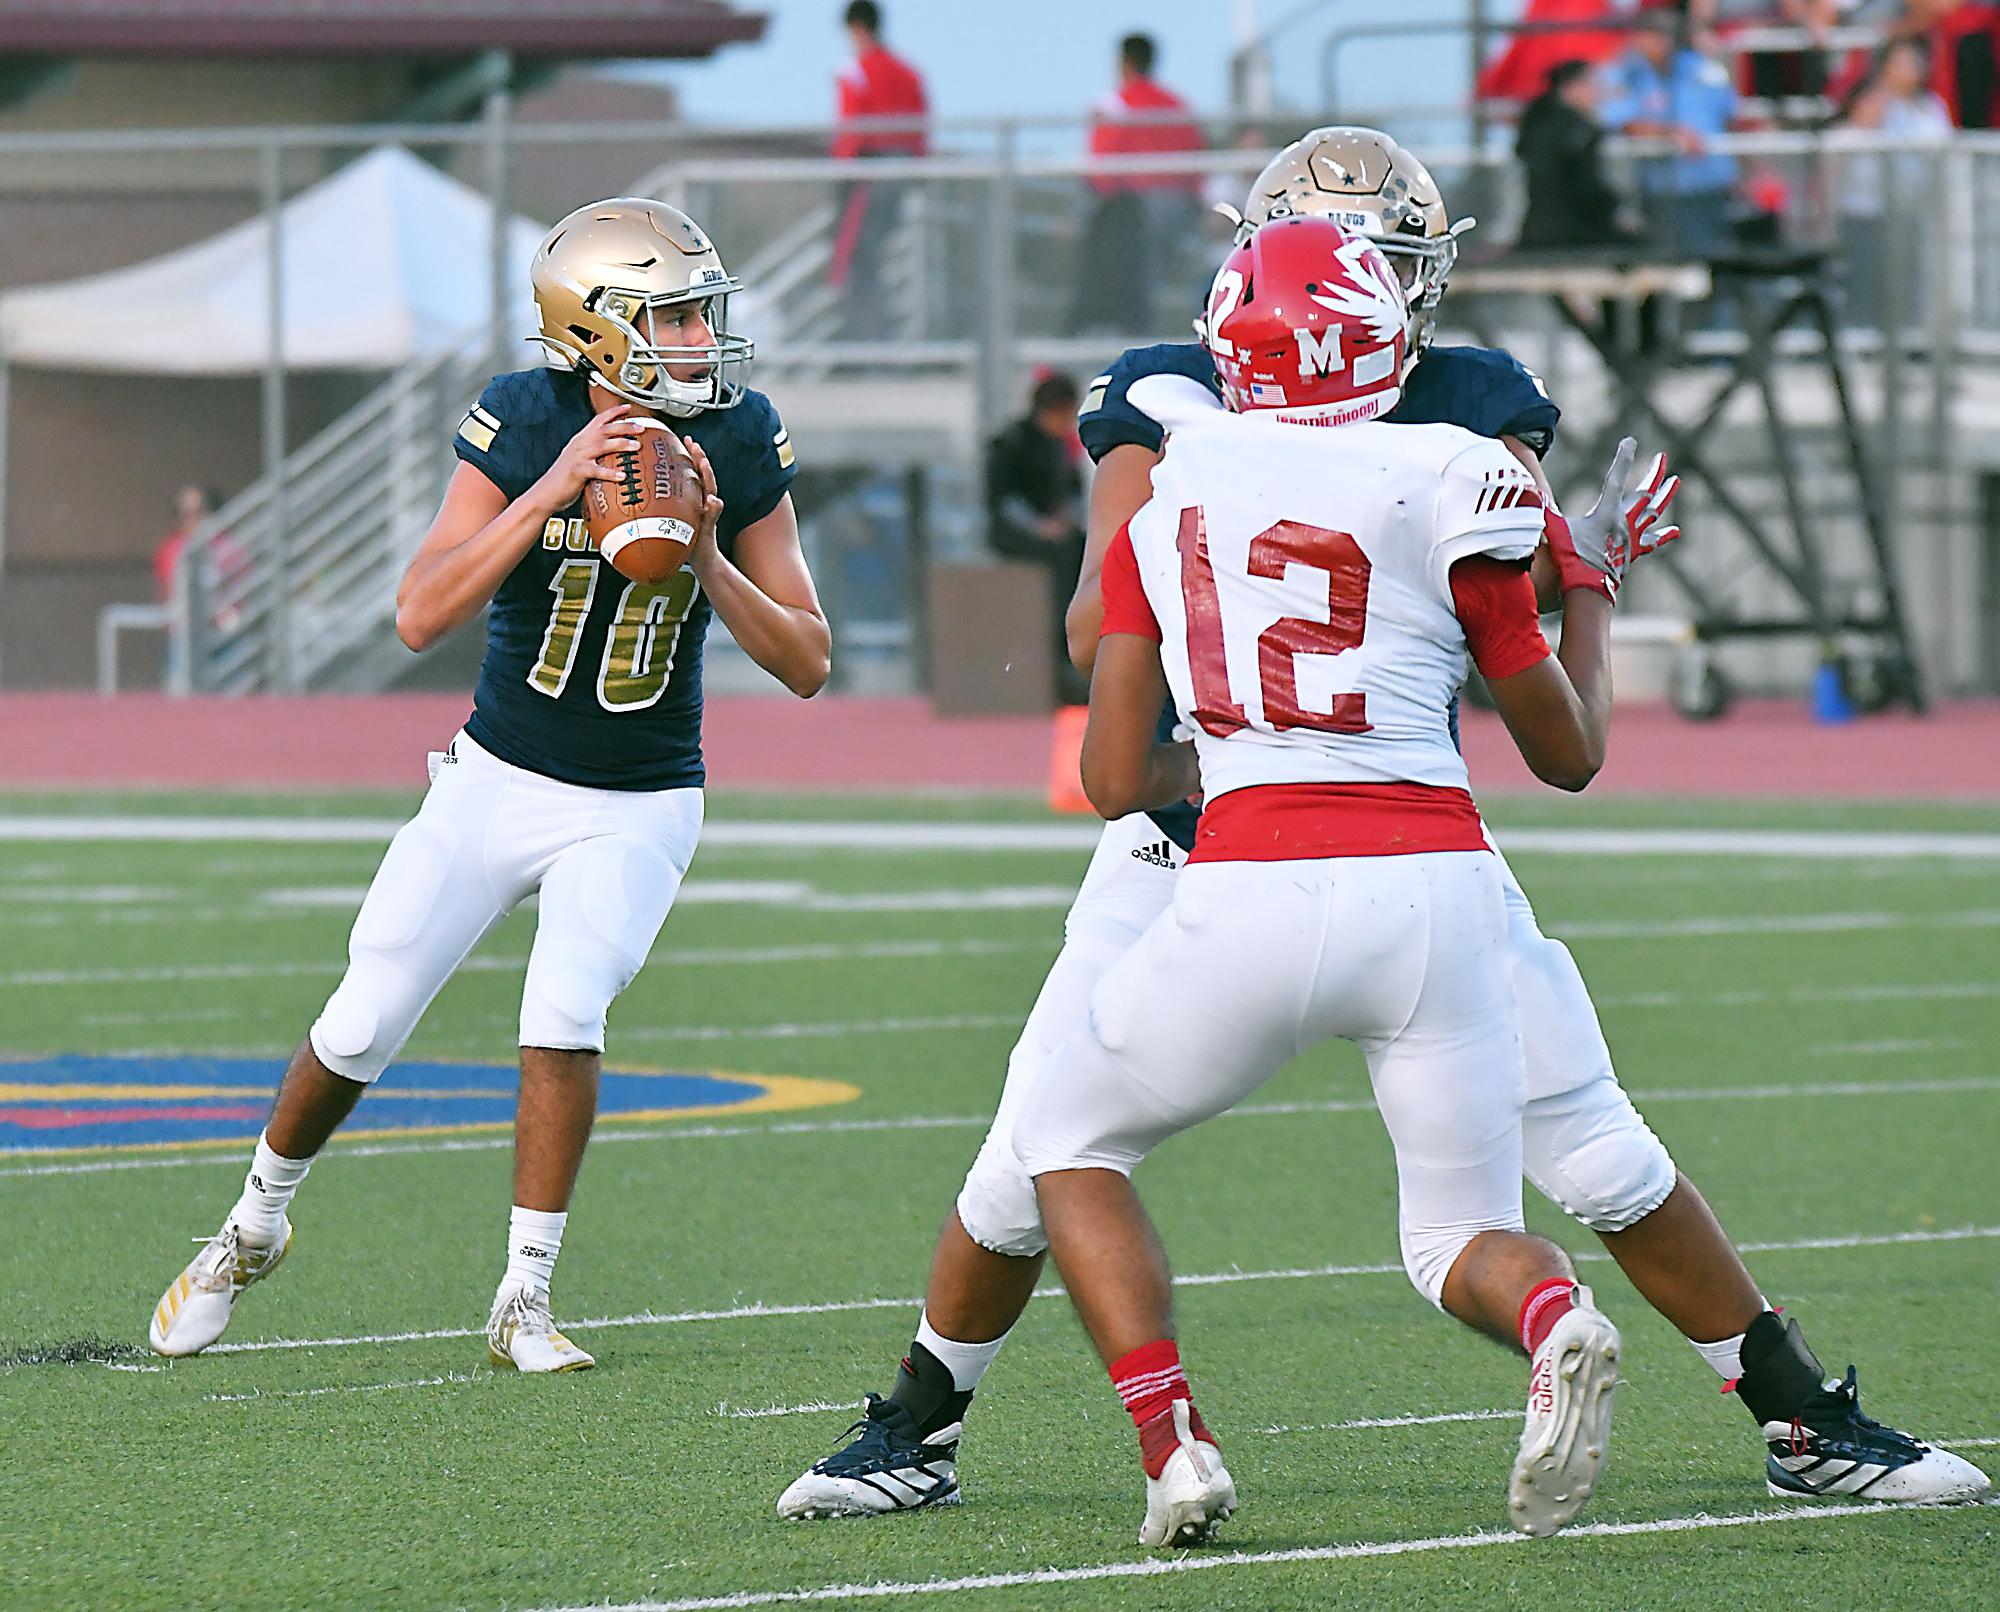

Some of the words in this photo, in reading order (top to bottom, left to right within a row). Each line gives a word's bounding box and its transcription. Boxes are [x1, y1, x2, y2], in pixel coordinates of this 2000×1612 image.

[1294, 322, 1346, 377] M
[652, 438, 672, 499] Wilson
[526, 558, 700, 713] 10
[1176, 505, 1375, 739] 12
[1131, 849, 1176, 870] adidas
[520, 1248, 548, 1259] adidas
